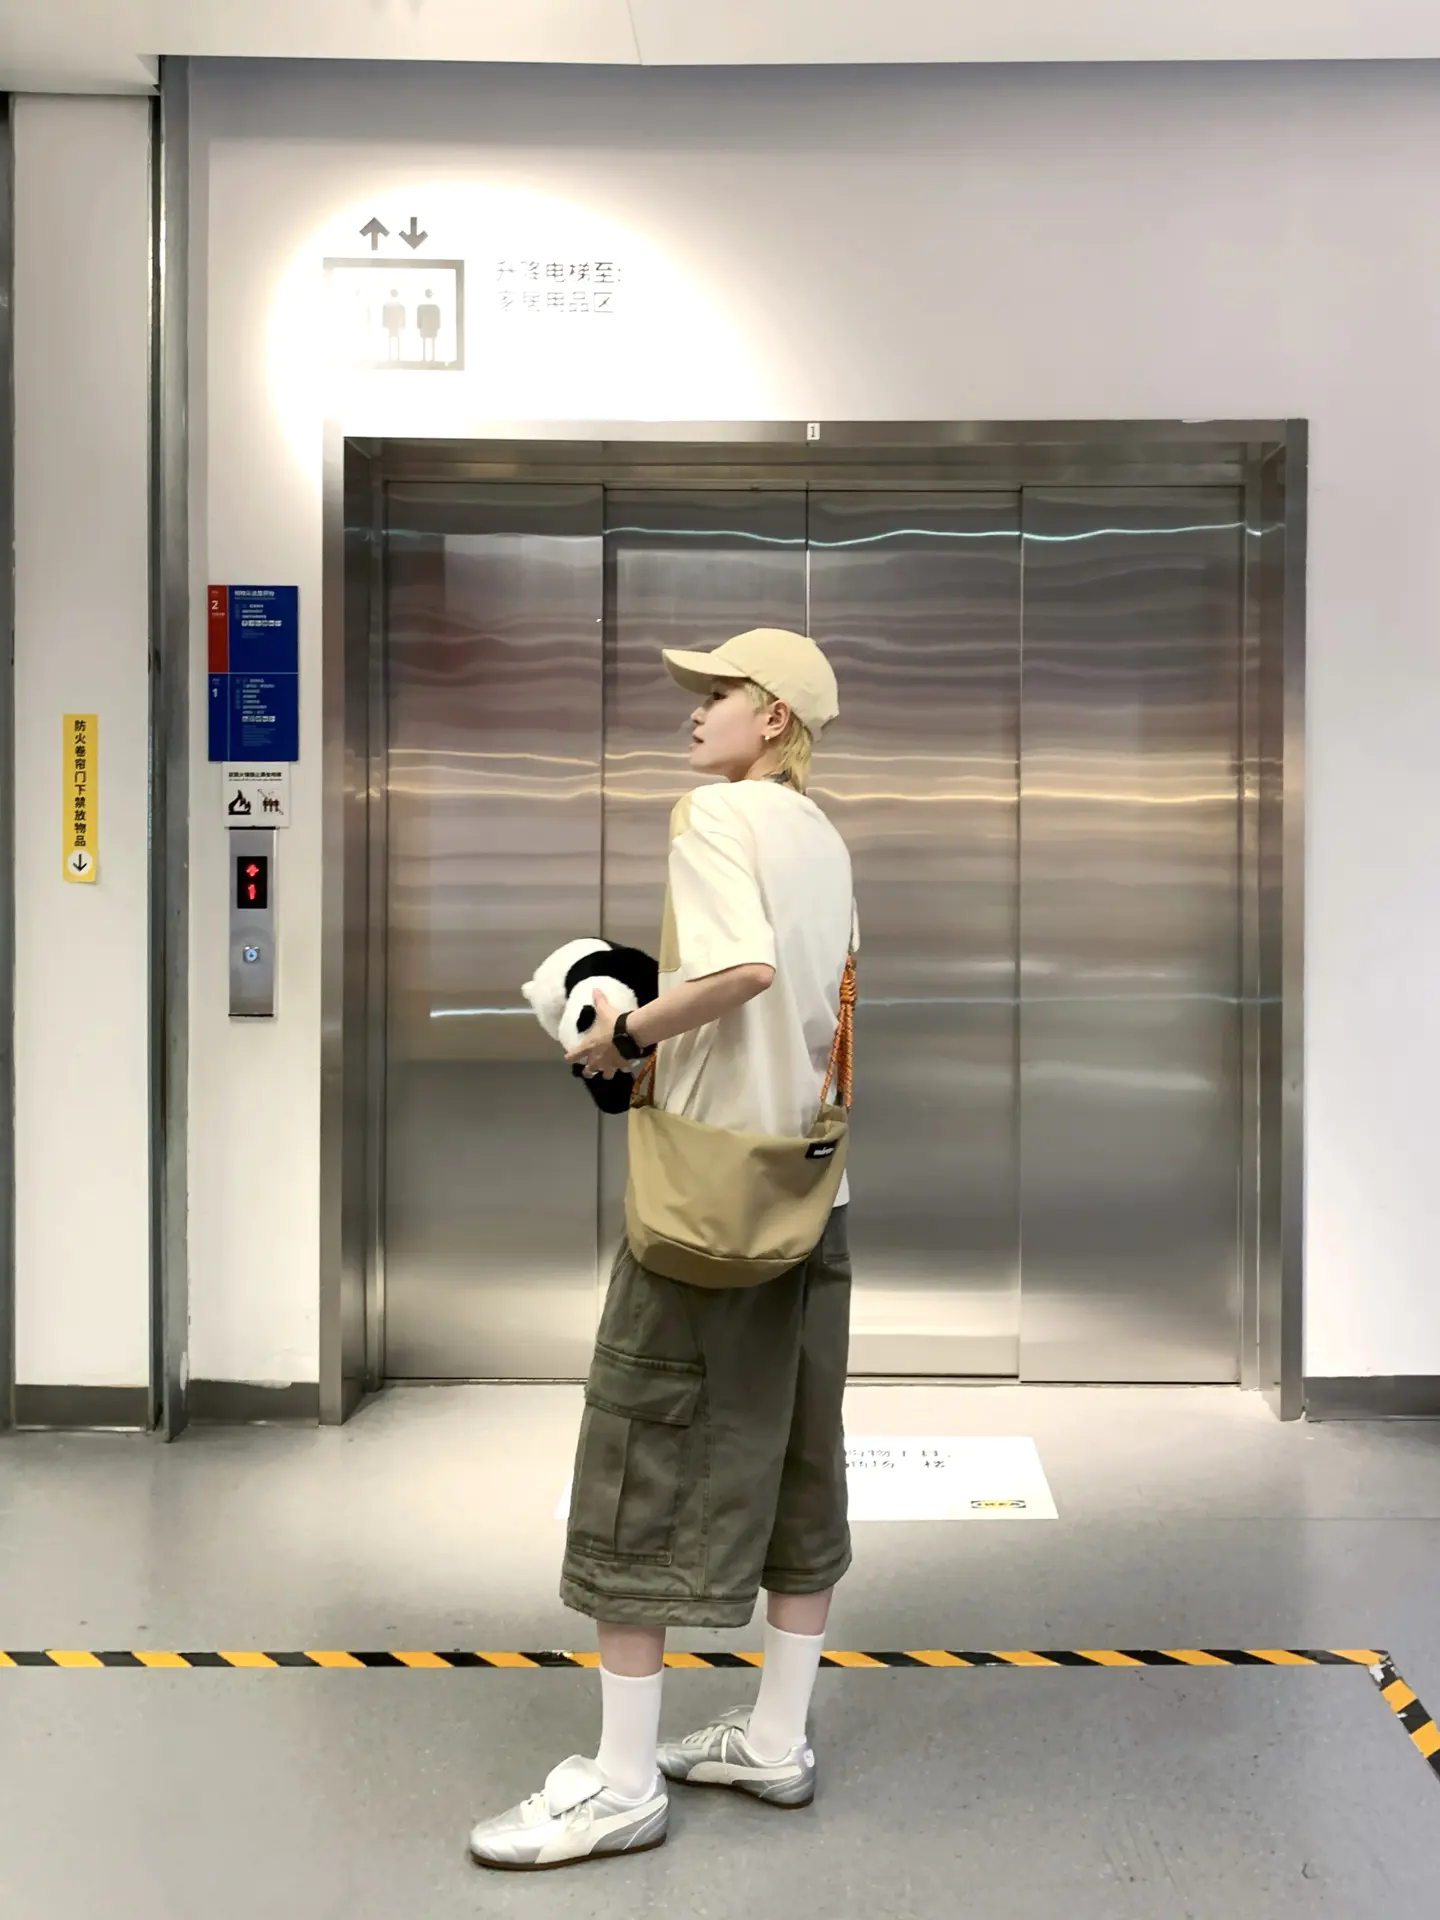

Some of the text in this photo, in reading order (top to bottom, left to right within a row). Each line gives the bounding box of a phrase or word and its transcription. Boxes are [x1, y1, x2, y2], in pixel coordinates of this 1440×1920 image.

[810, 426, 817, 438] 1
[211, 600, 219, 610] 2
[212, 688, 218, 698] 1
[74, 720, 86, 847] 防火卷帘门下禁放物品
[247, 884, 256, 900] 1
